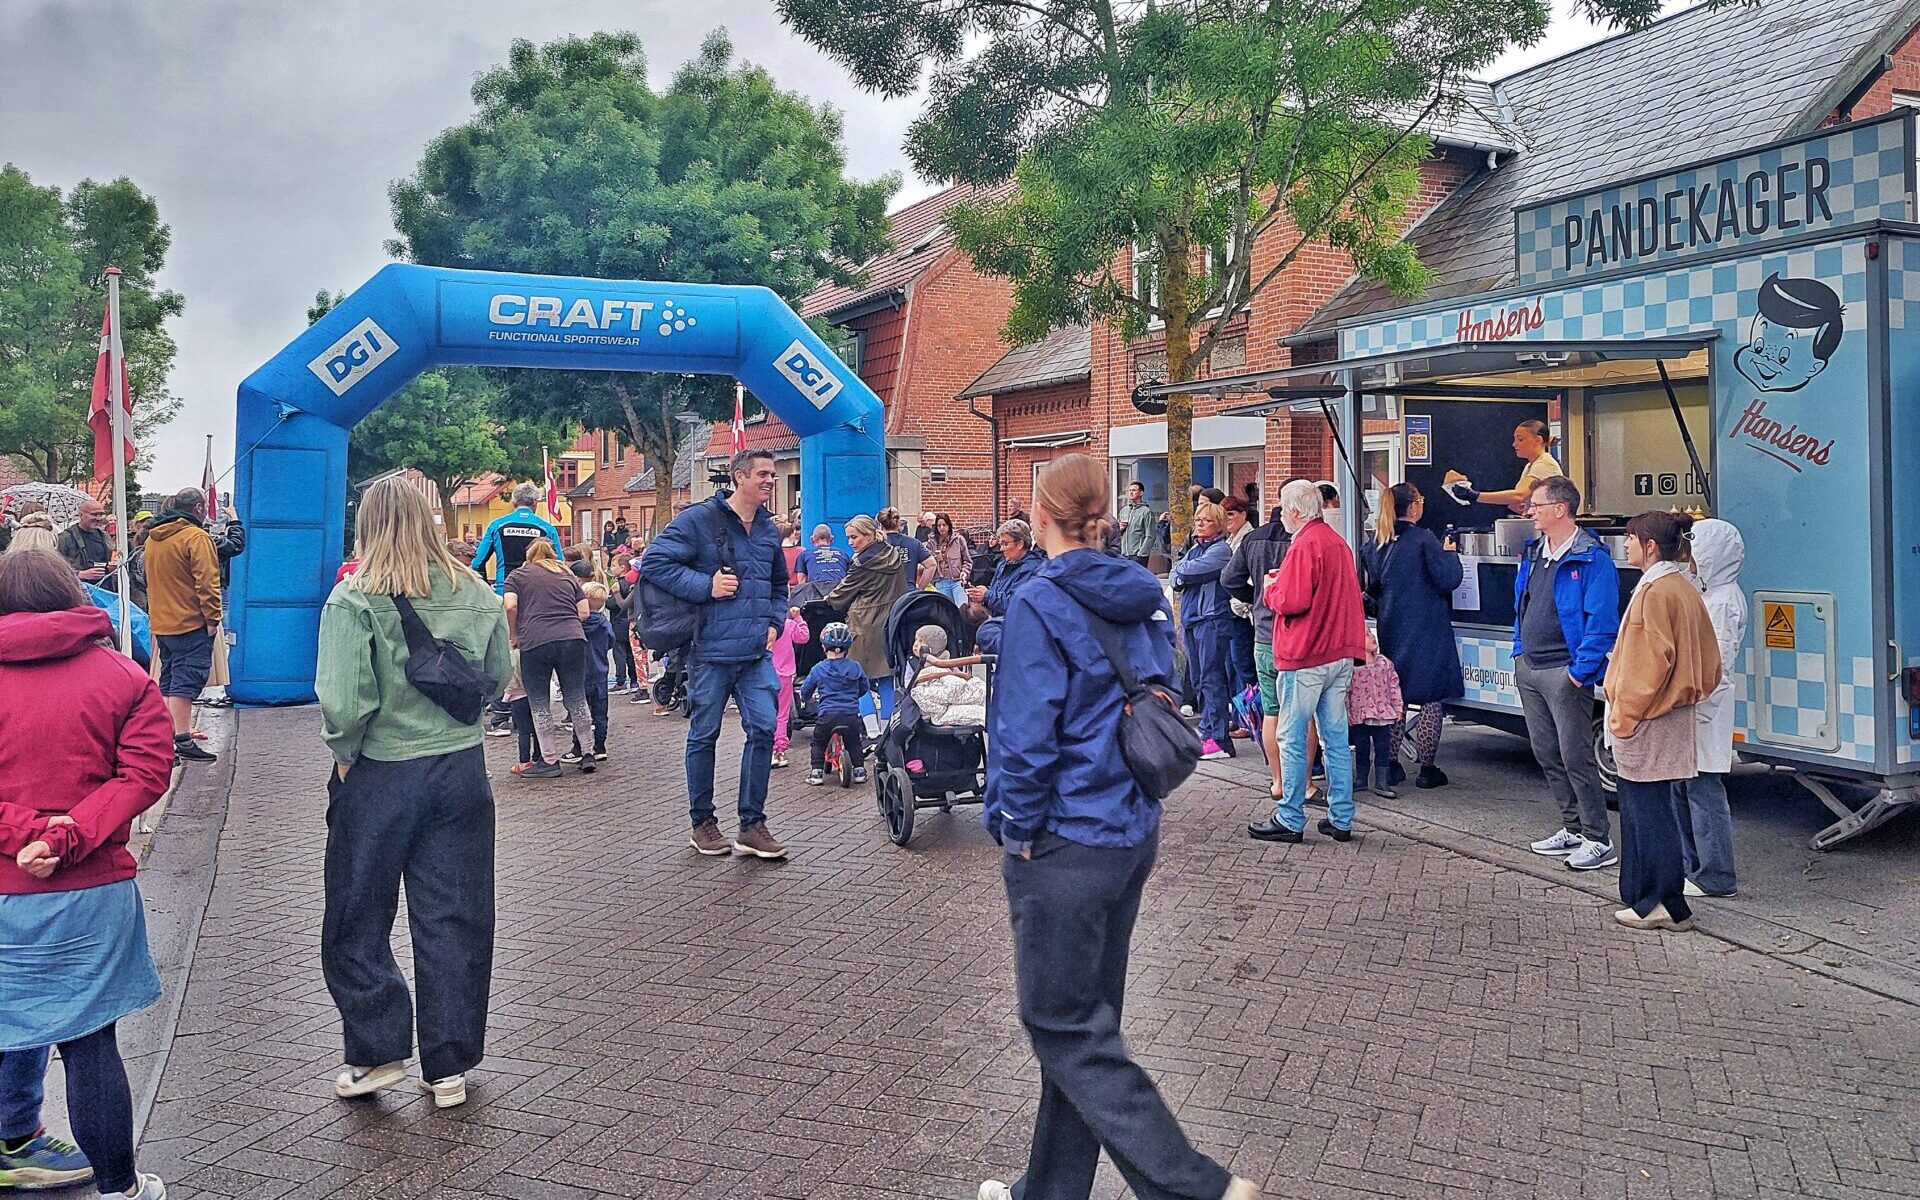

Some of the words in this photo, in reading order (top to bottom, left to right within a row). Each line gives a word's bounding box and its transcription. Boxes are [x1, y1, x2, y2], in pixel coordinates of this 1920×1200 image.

[1565, 157, 1833, 272] PANDEKAGER
[489, 294, 654, 331] CRAFT
[1456, 296, 1545, 342] Hansens
[325, 329, 382, 384] DGI
[489, 331, 561, 343] FUNCTIONAL
[563, 334, 640, 346] SPORTSWEAR
[785, 353, 834, 397] DGI
[1729, 398, 1835, 466] Hansens
